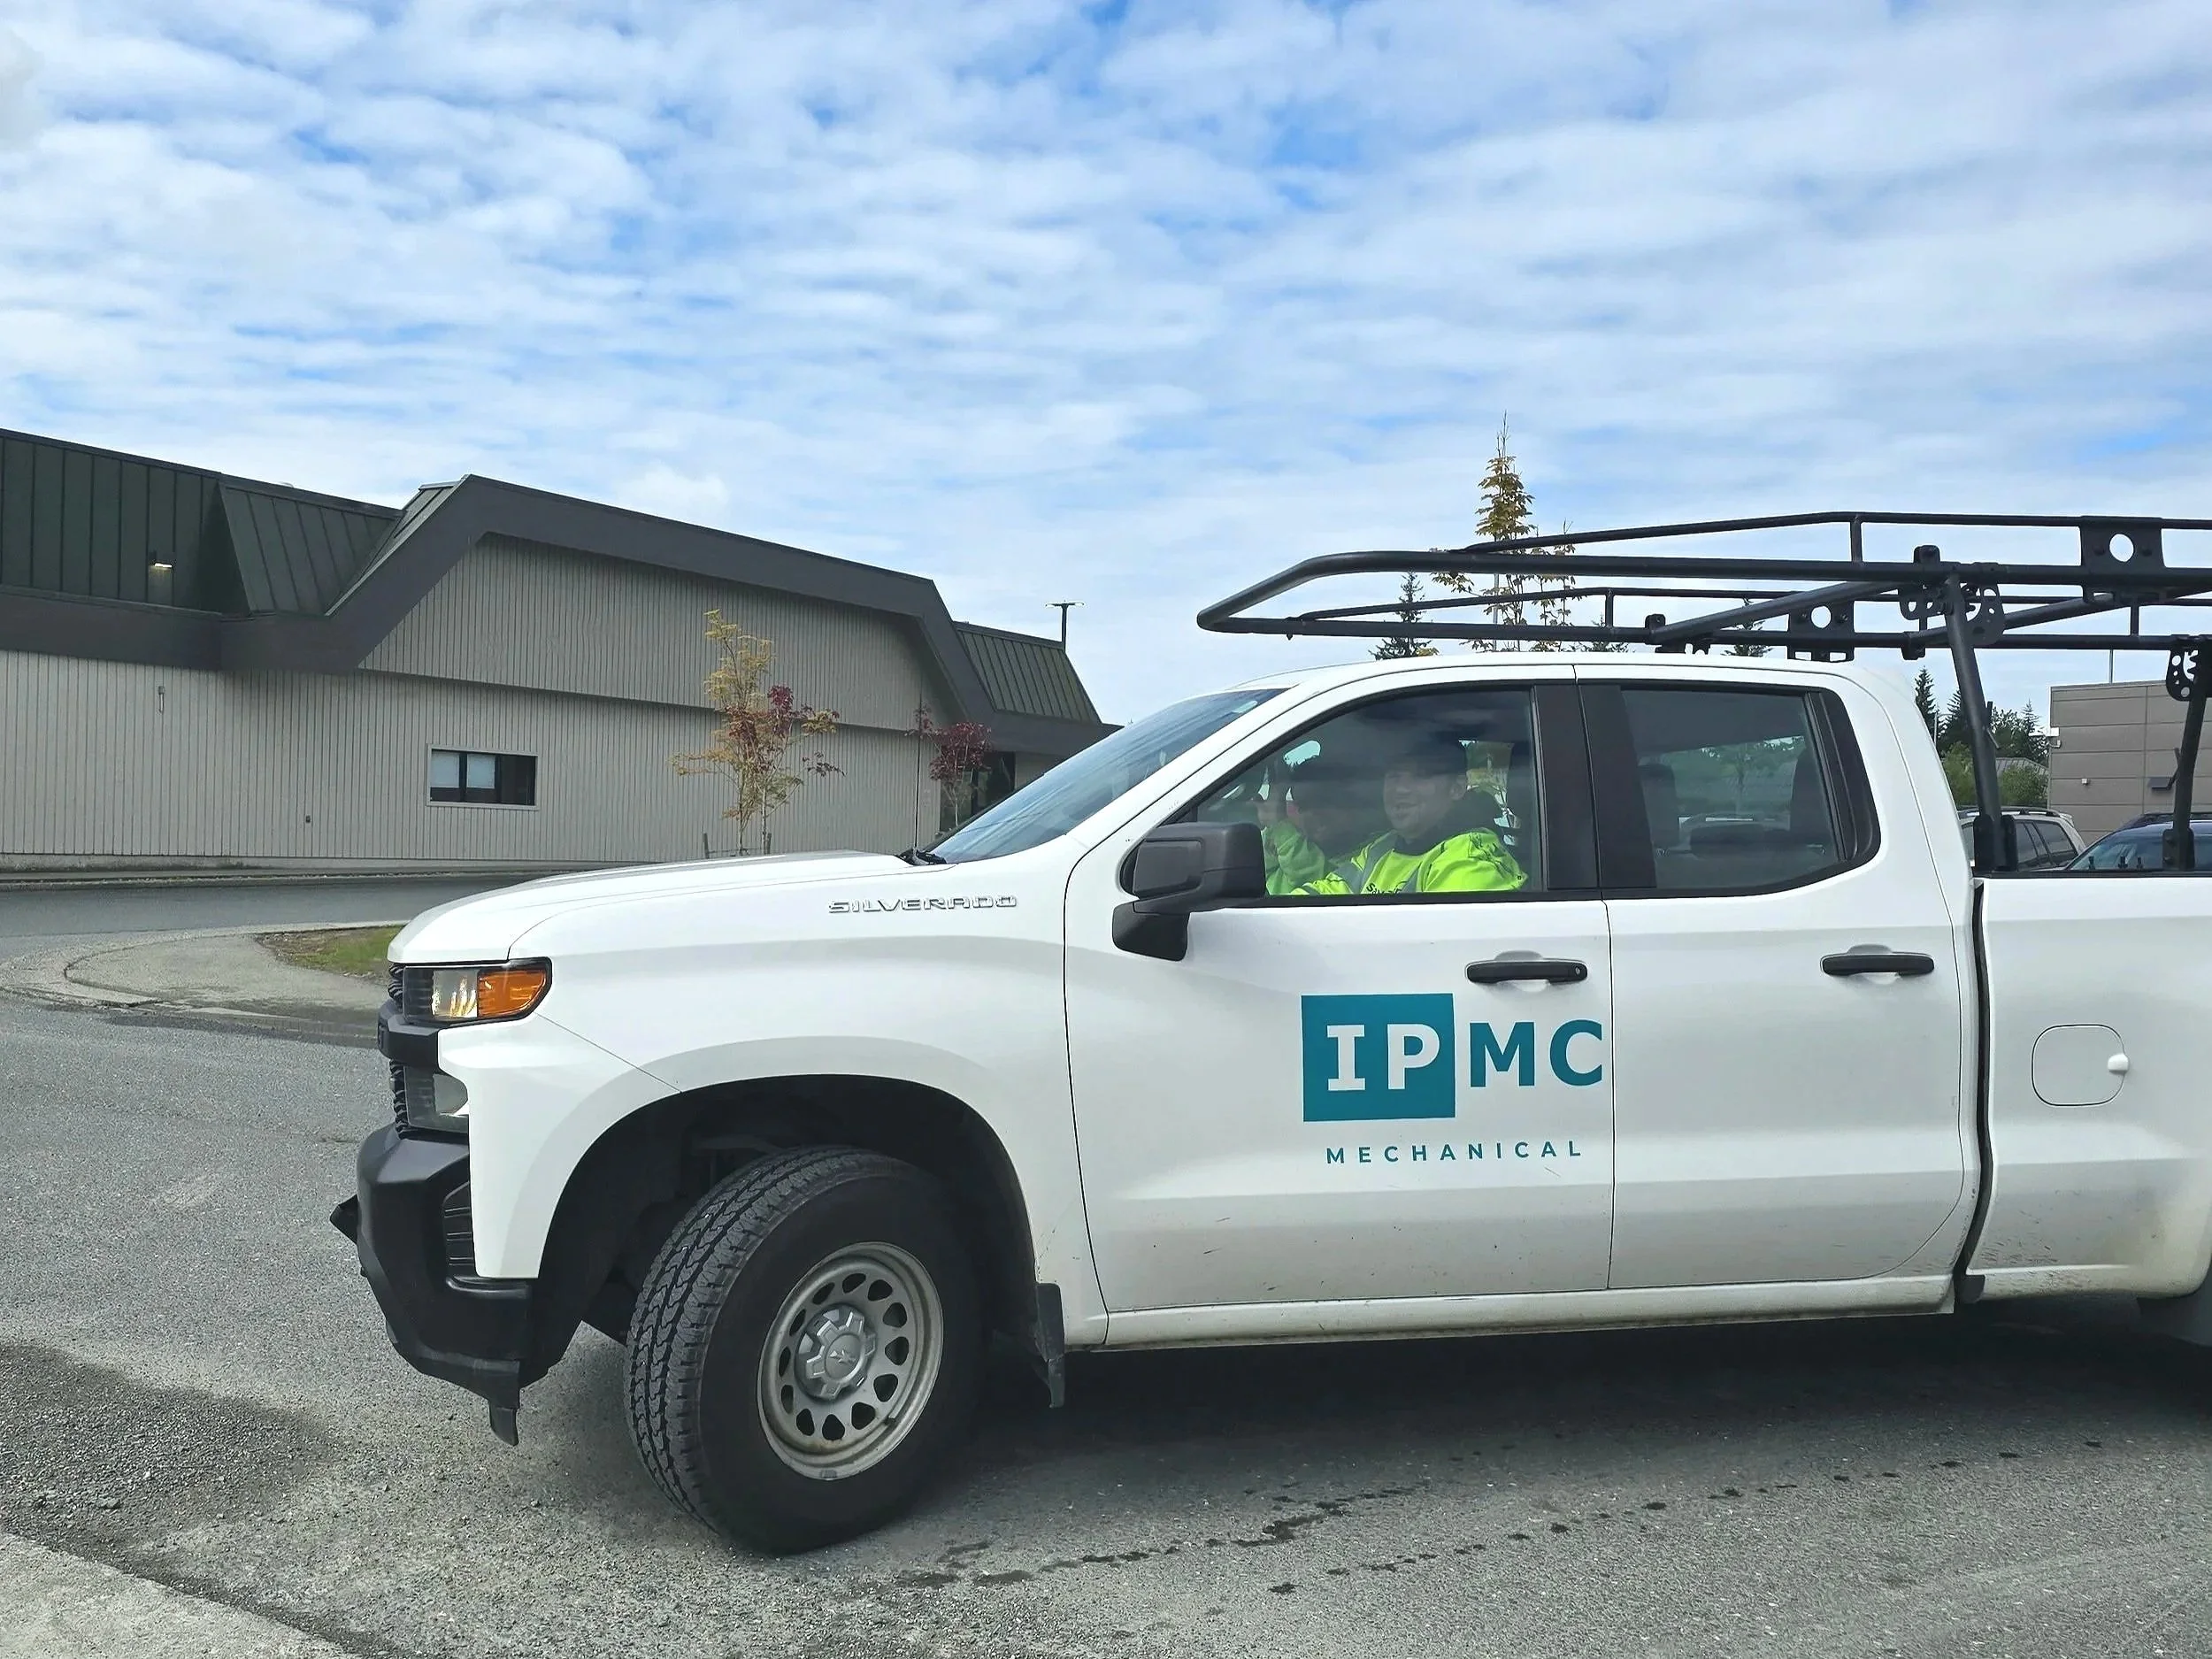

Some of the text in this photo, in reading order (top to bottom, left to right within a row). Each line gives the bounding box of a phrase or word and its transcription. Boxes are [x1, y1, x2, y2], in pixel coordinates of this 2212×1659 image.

[828, 895, 1018, 914] SILVERADO
[1326, 1018, 1604, 1091] IPMC
[1325, 1140, 1582, 1164] MECHANICAL
